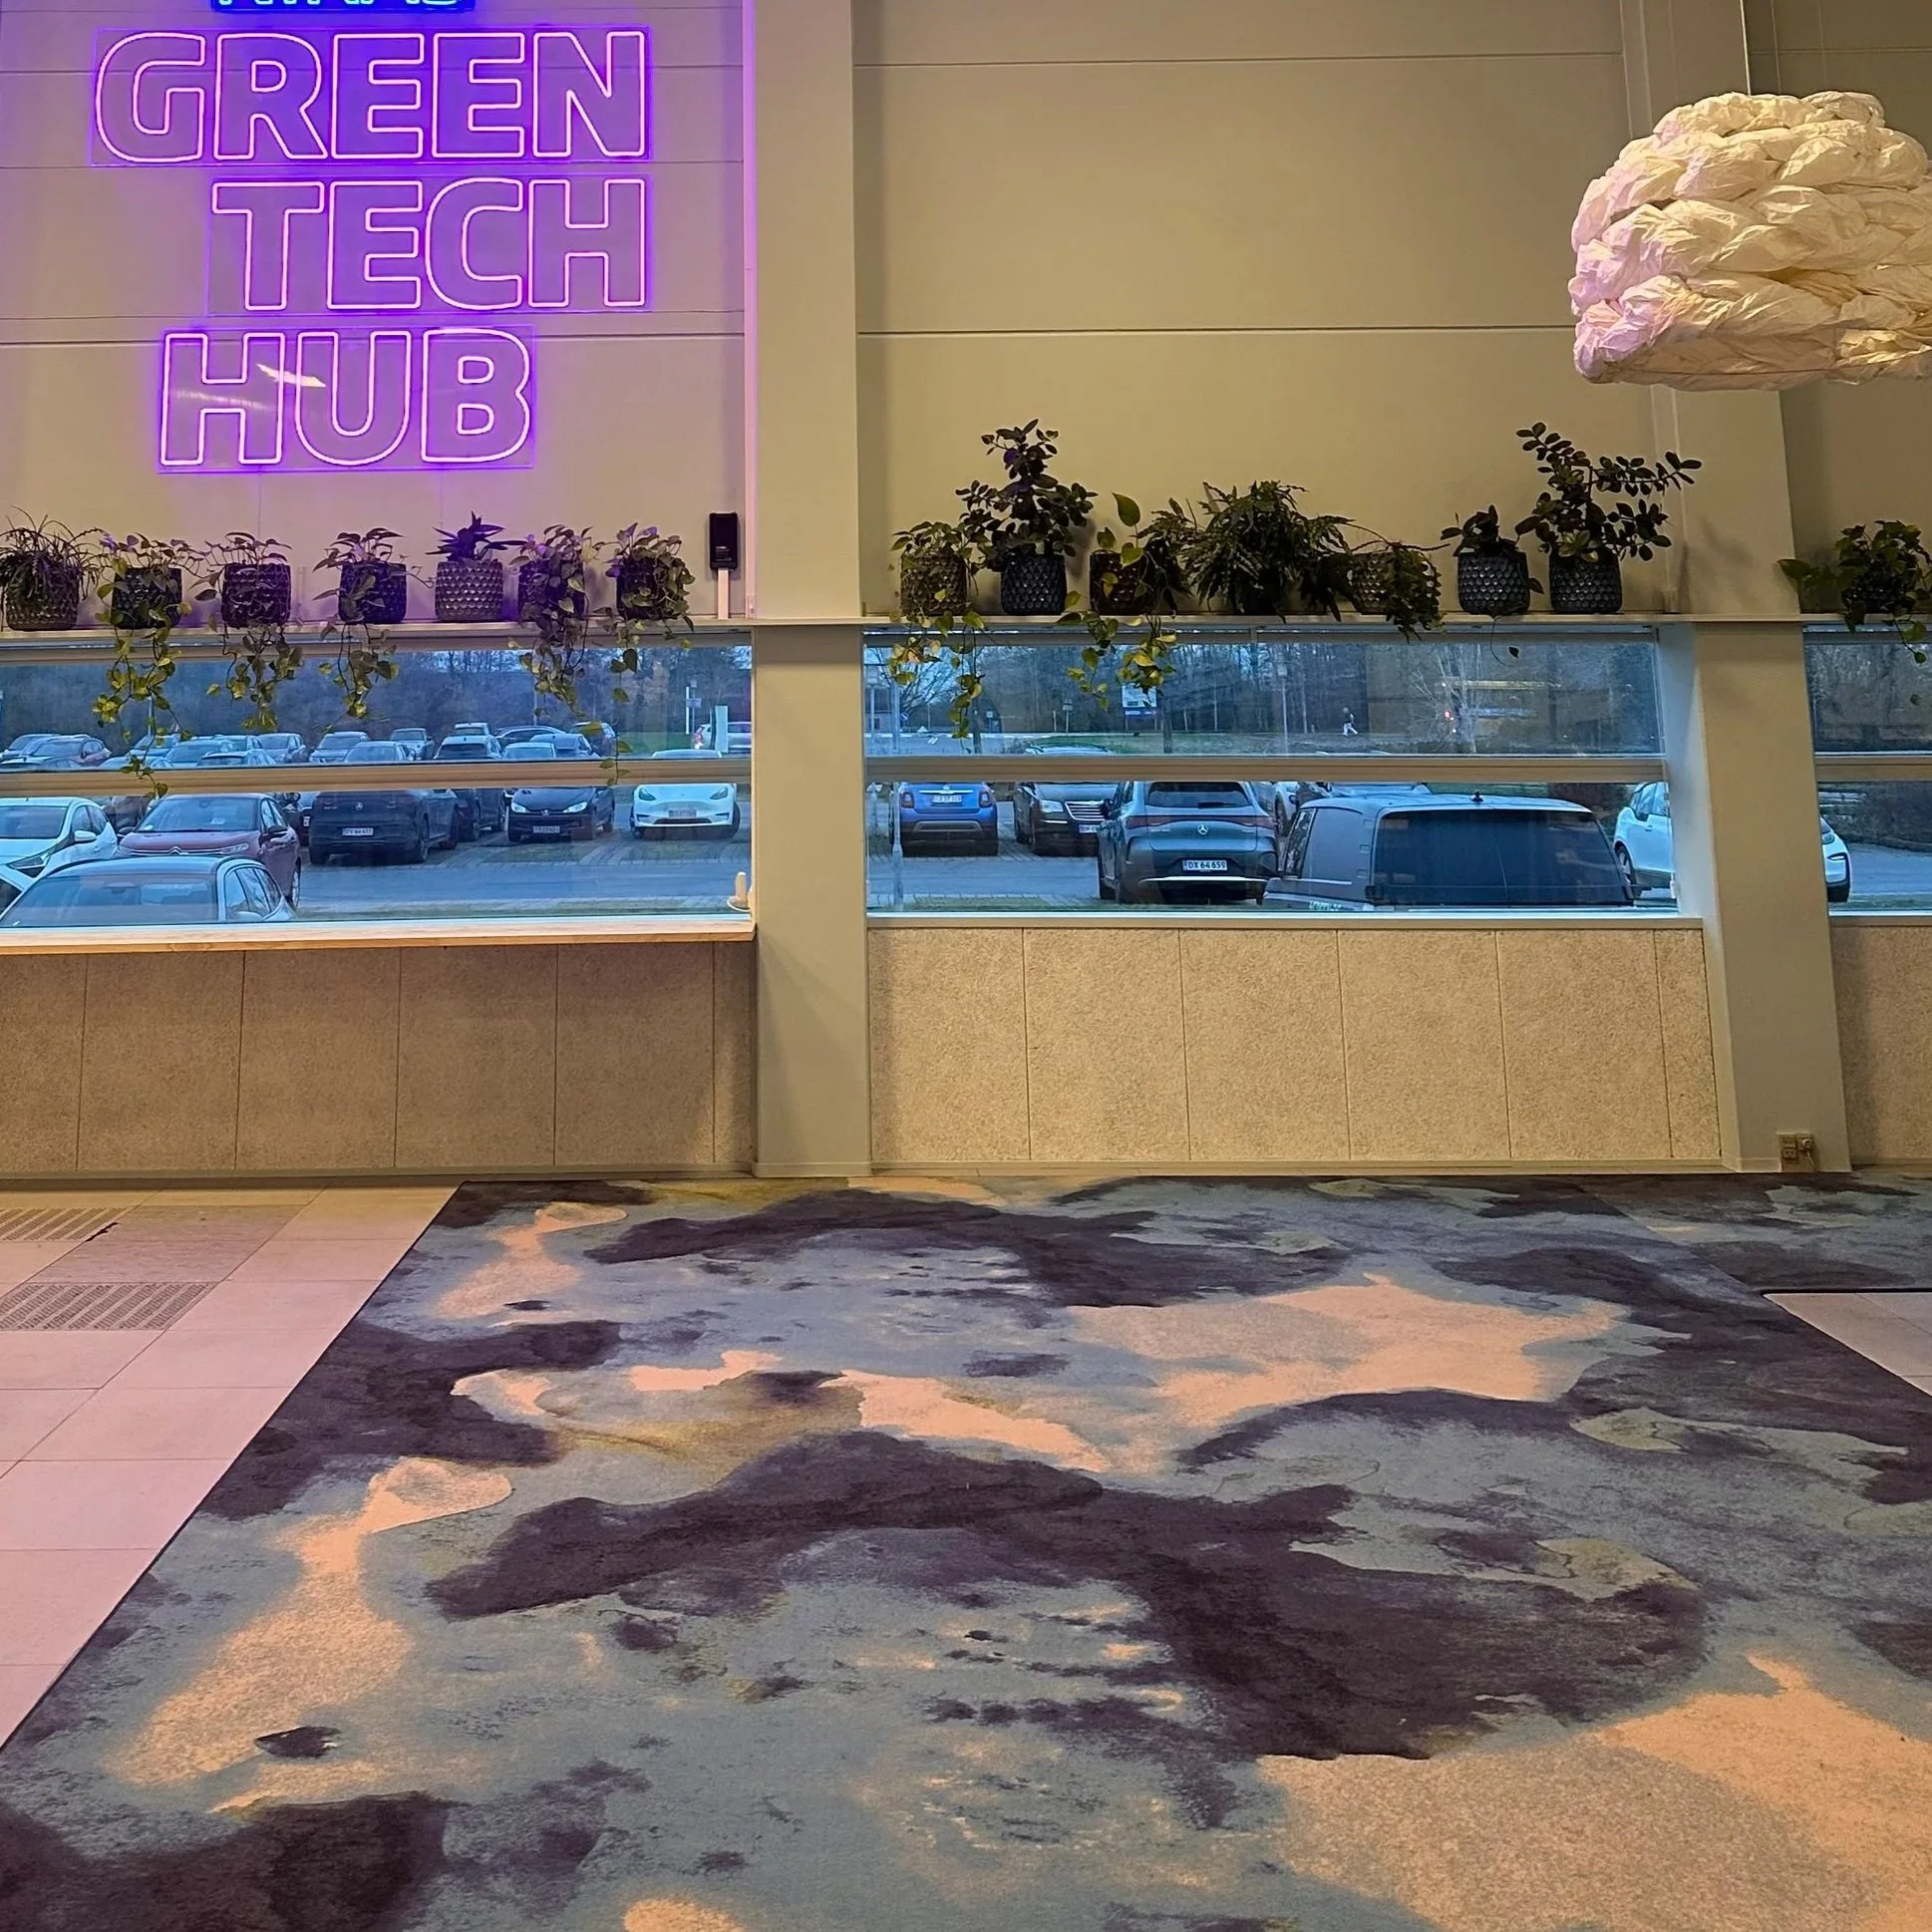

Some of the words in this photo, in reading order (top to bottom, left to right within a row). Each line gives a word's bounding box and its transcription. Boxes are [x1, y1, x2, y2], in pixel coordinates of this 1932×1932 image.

[96, 31, 646, 162] GREEN
[211, 176, 646, 311] TECH
[160, 327, 531, 467] HUB
